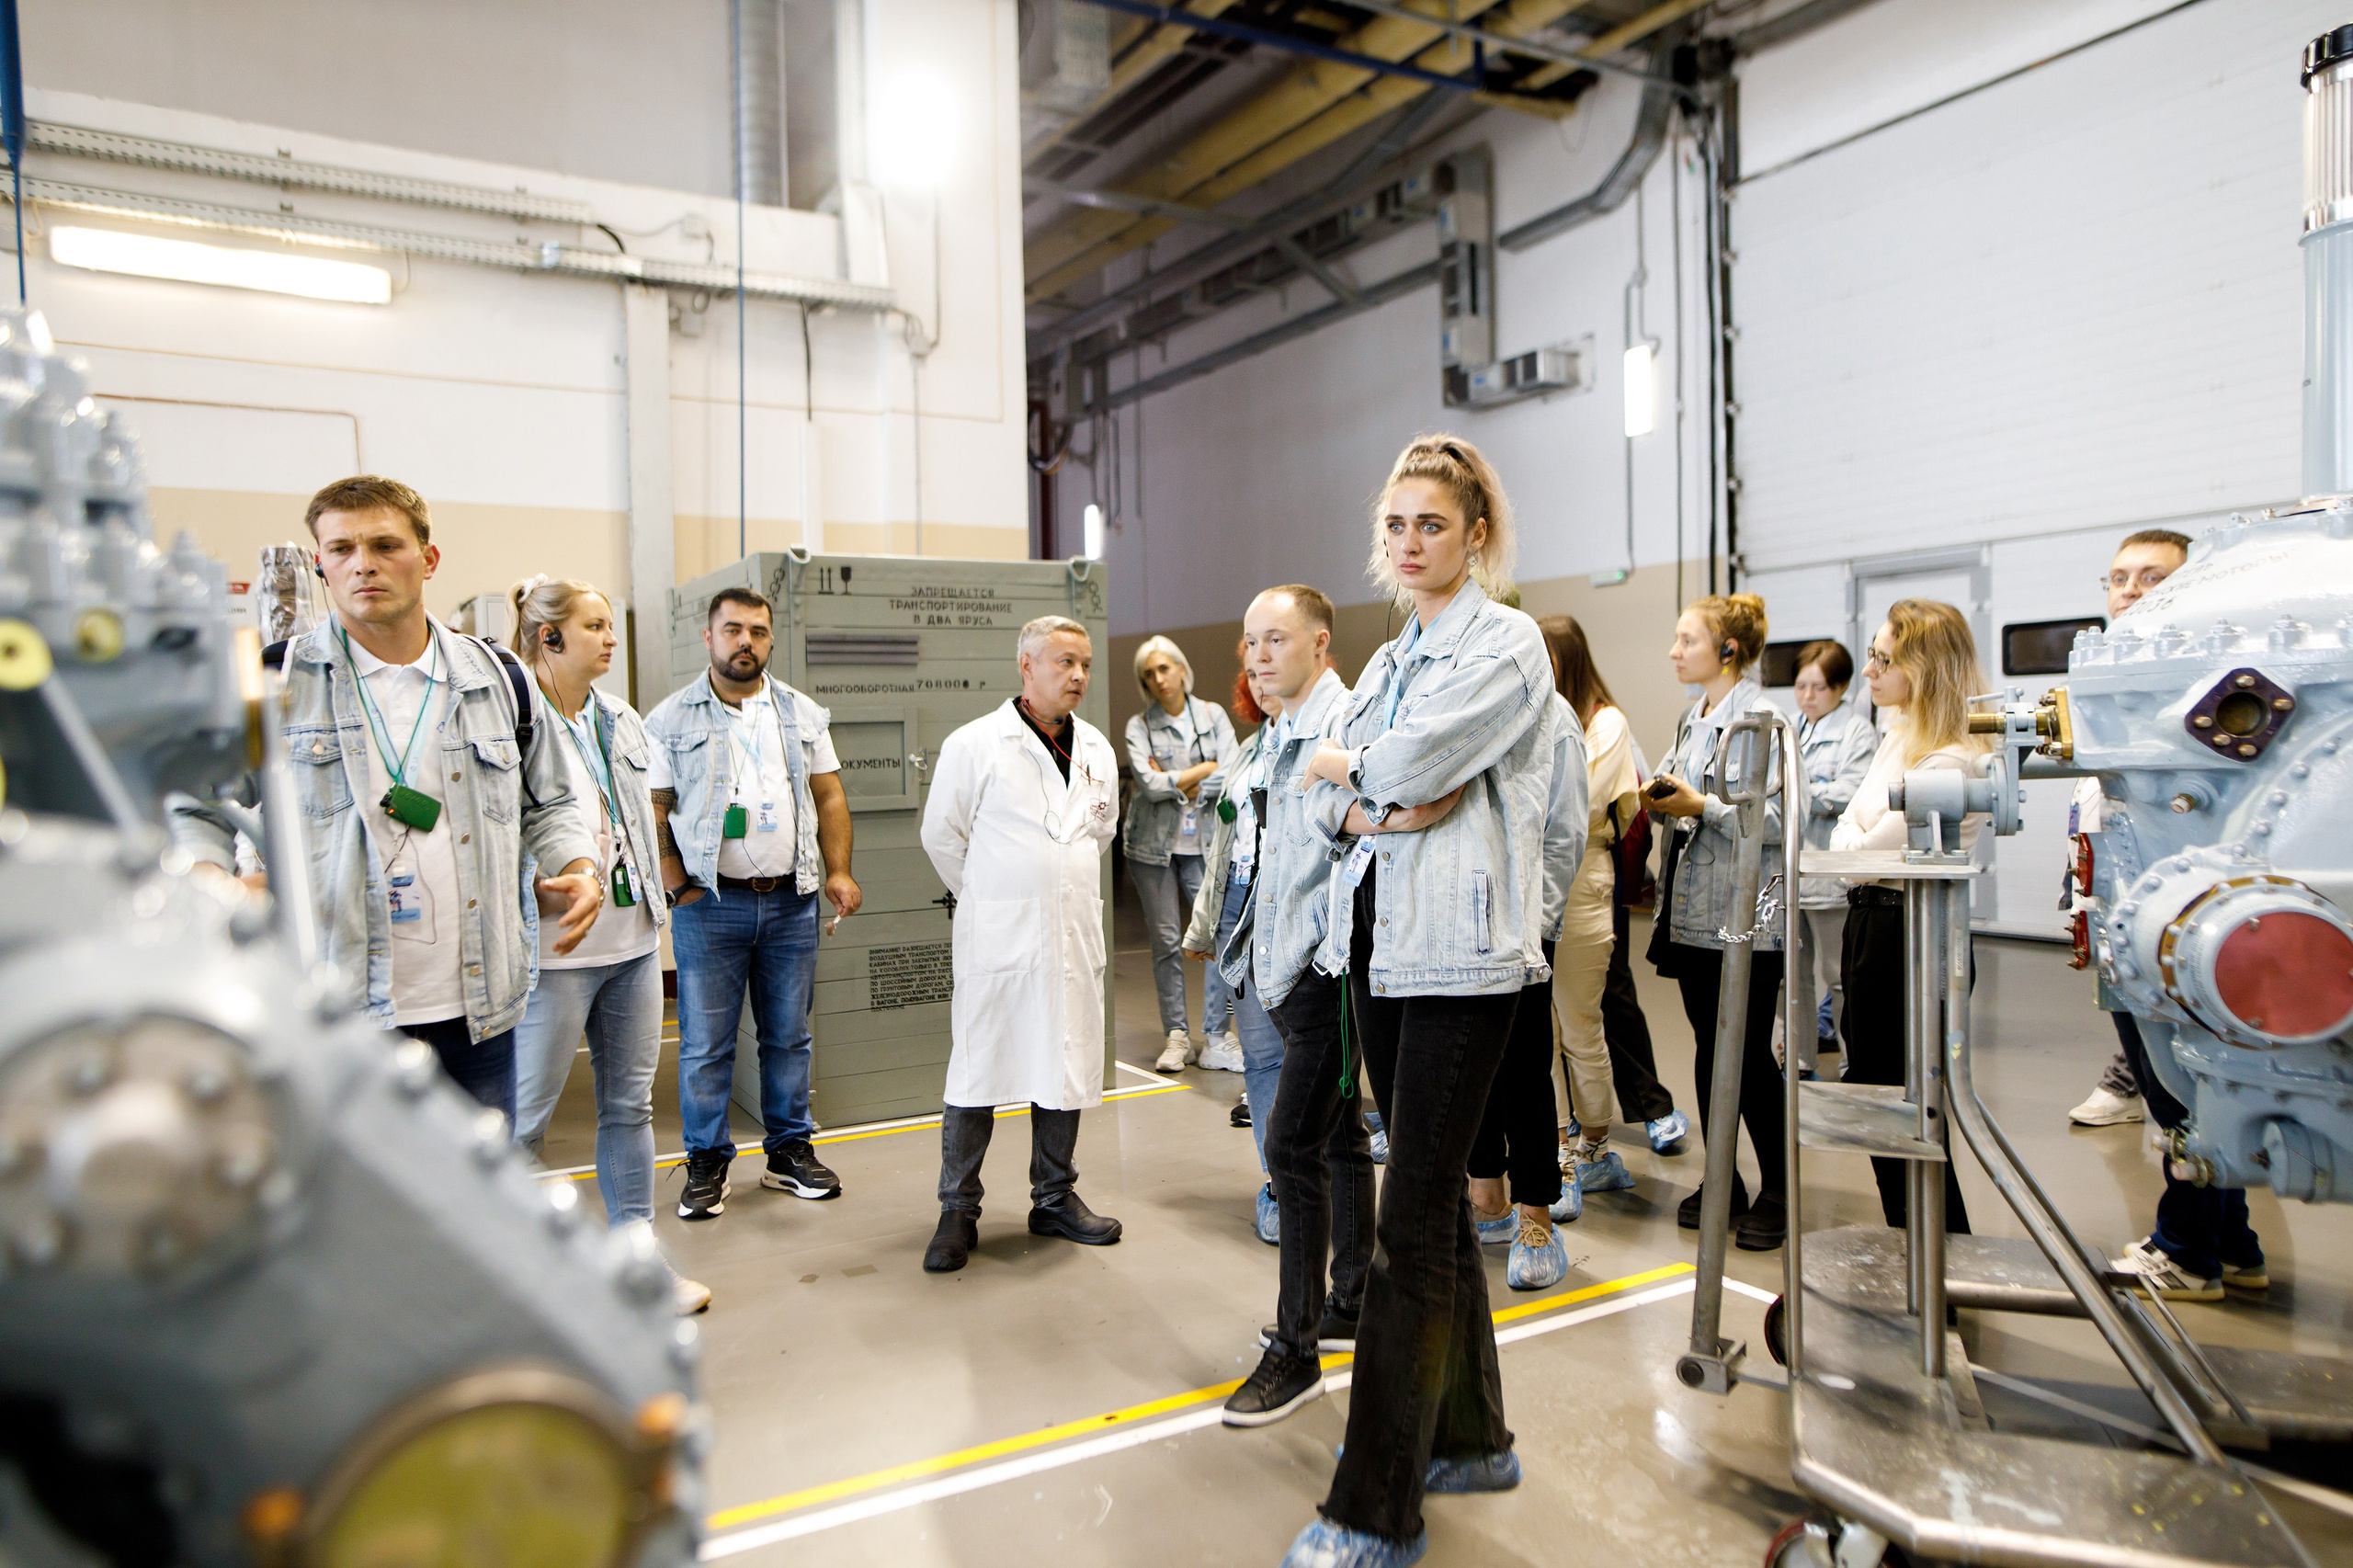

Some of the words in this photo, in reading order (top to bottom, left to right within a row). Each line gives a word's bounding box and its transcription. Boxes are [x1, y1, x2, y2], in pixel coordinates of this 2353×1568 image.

[911, 586, 995, 599] ЗАПРЕЩАЕТСЯ
[889, 599, 1013, 613] ТРАНСПОРТИРОВАНИЕ
[914, 615, 921, 625] В
[927, 615, 951, 626] ДВА
[958, 615, 994, 626] ЯРУСА
[815, 684, 915, 694] МНОГООБОРОТНАЯ
[837, 758, 901, 771] ОКУМЕНТЫ
